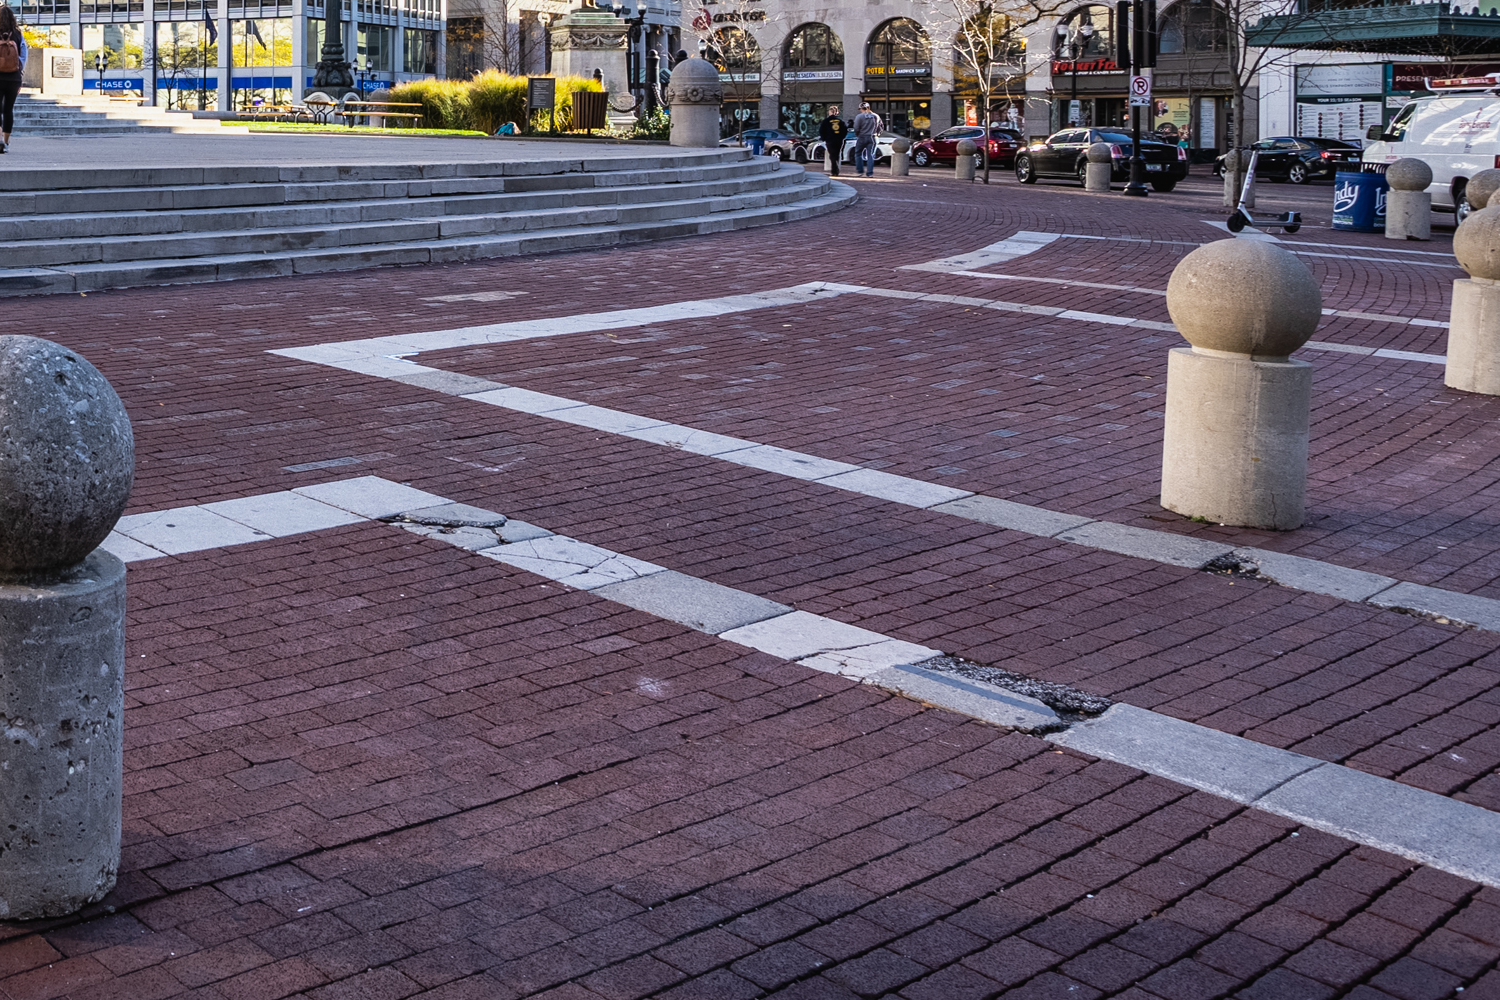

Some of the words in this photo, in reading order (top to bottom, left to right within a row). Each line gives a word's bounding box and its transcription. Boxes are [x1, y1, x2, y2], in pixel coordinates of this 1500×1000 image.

[1052, 60, 1096, 73] ROCKET
[1095, 58, 1122, 70] FIZ
[363, 81, 380, 90] CHASE
